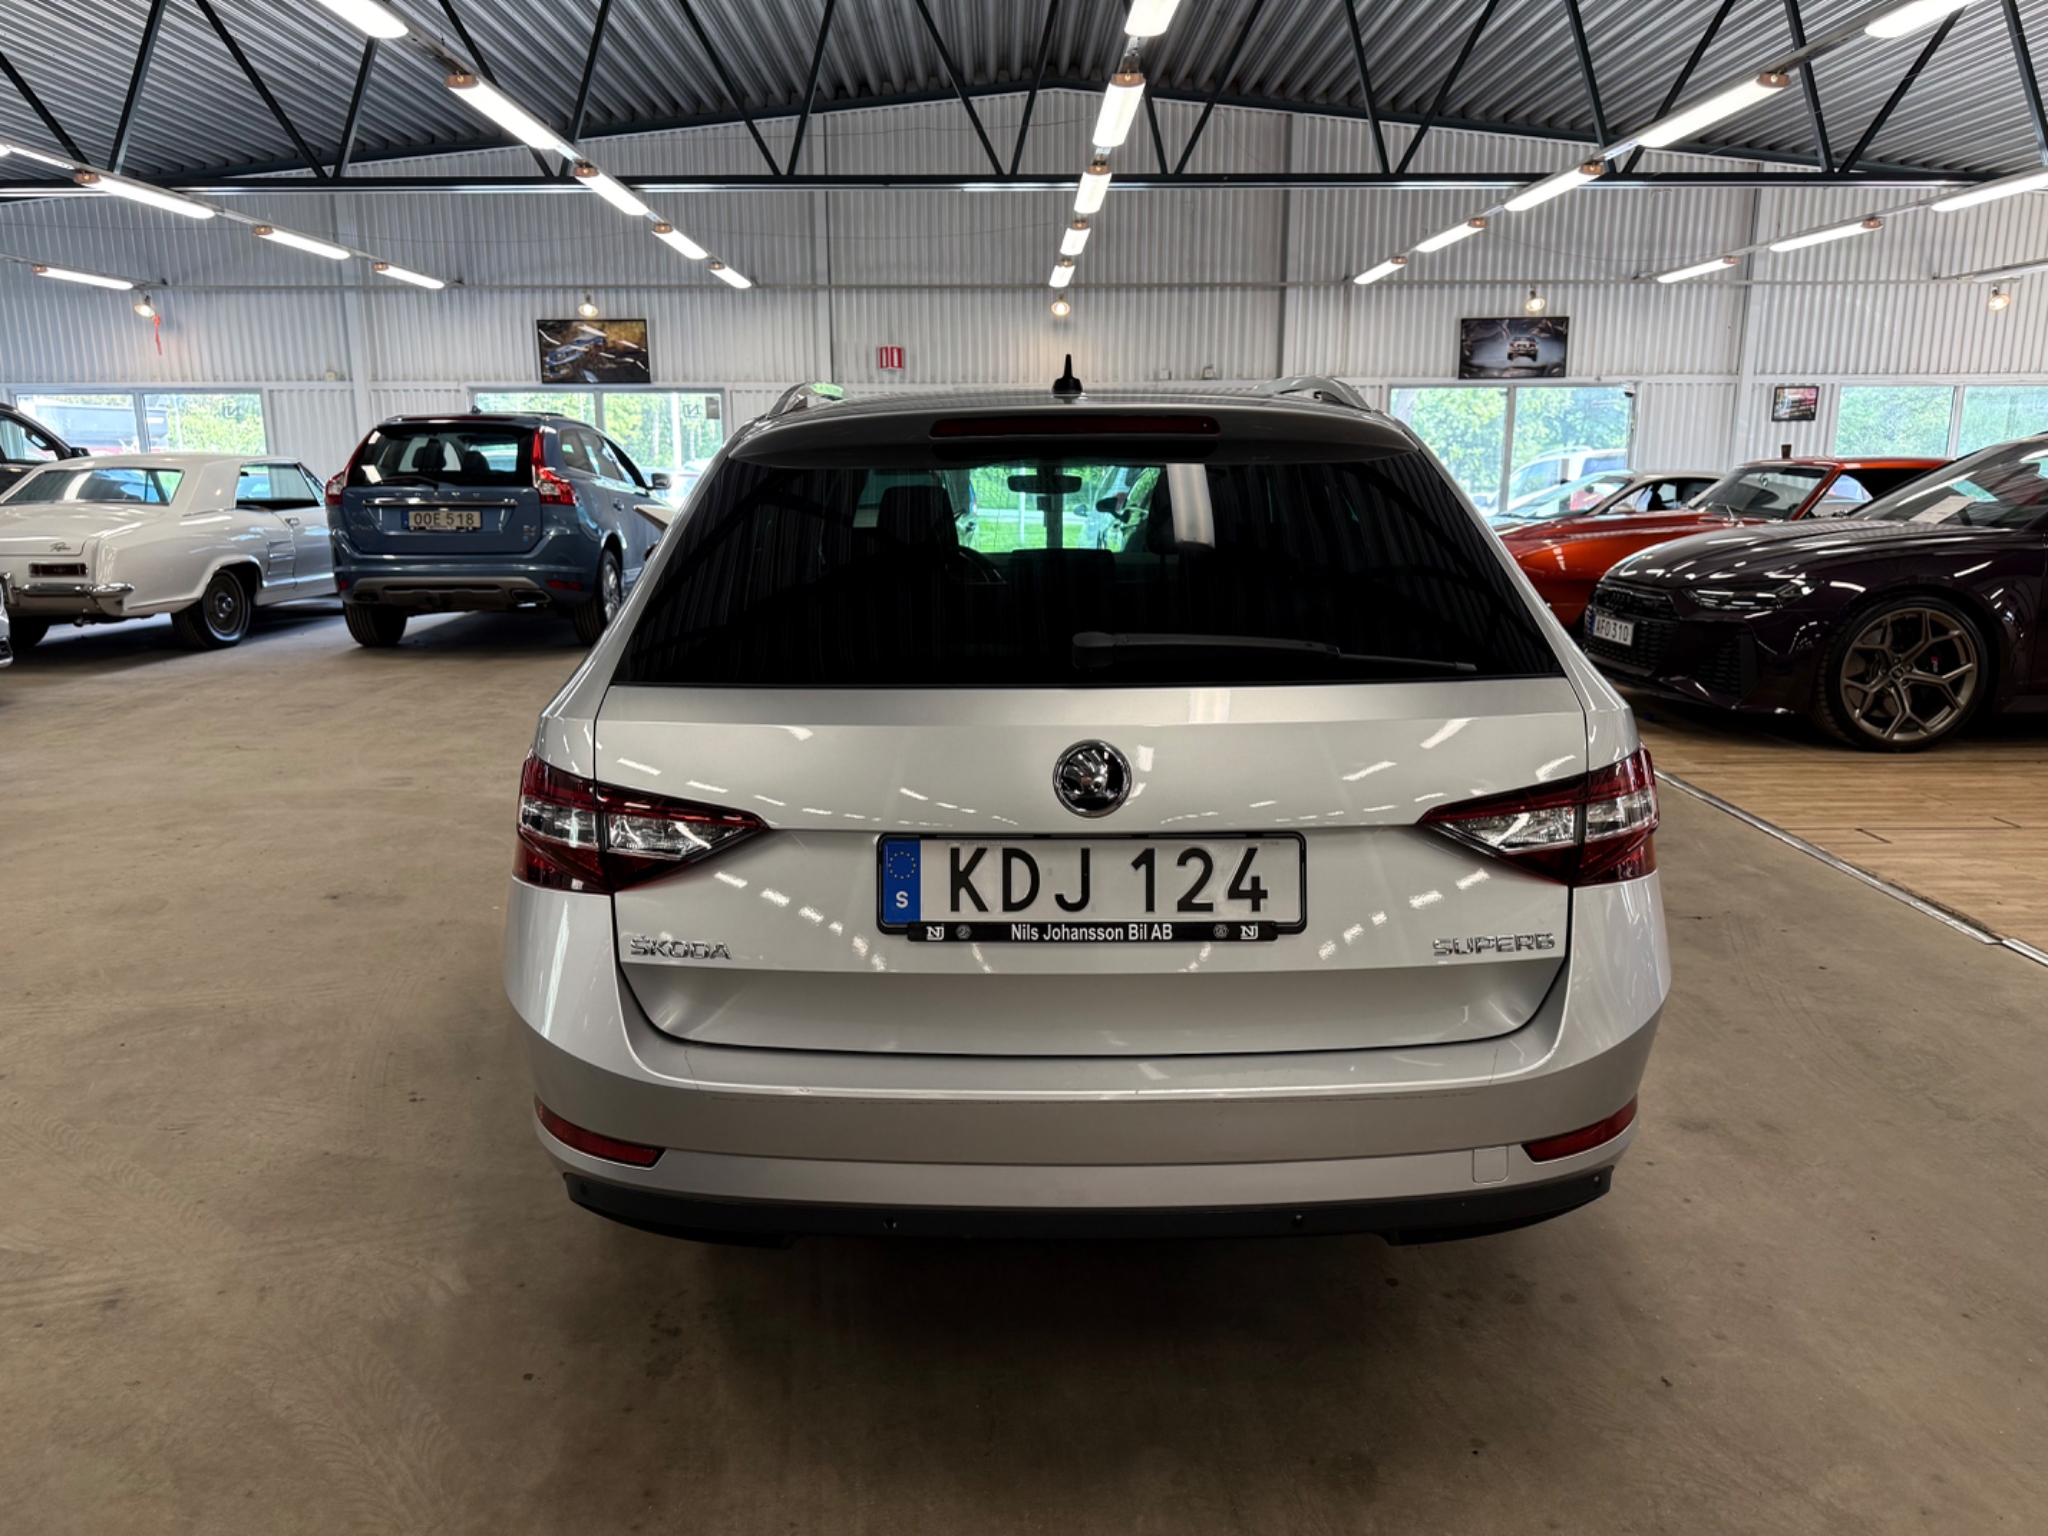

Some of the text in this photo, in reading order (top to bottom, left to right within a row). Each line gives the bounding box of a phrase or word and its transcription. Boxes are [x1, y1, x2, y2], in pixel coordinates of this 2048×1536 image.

[446, 512, 475, 526] 518
[949, 847, 1269, 913] KDJ 124
[895, 891, 909, 909] S
[1011, 923, 1173, 941] Nils Johansson Bil AB
[630, 934, 732, 960] ŠKODA
[1432, 932, 1556, 957] SUPERB
